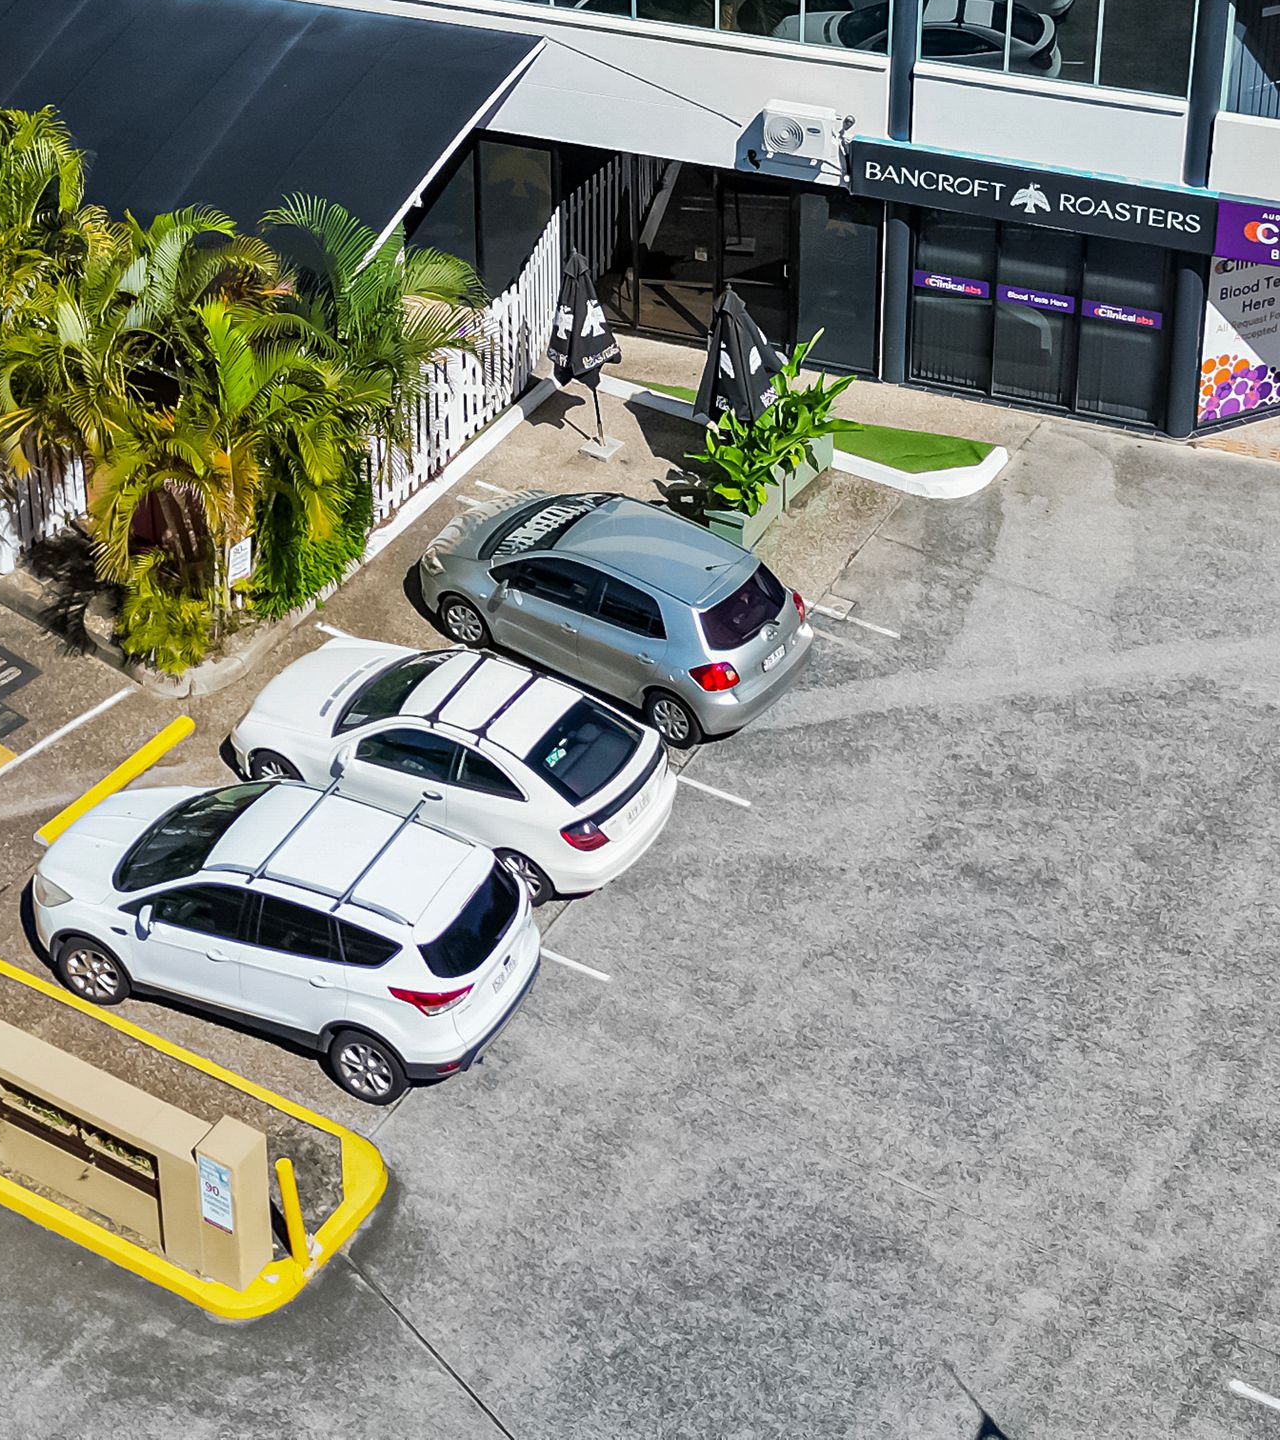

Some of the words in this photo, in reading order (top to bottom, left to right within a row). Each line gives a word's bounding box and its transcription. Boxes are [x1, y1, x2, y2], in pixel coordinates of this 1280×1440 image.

[865, 161, 1007, 202] BANCROFT
[1058, 193, 1201, 234] ROASTERS
[1220, 279, 1260, 300] Blood
[1242, 296, 1276, 313] Here
[1231, 315, 1267, 330] Request
[1234, 324, 1278, 342] Accepted
[205, 1181, 220, 1197] 90
